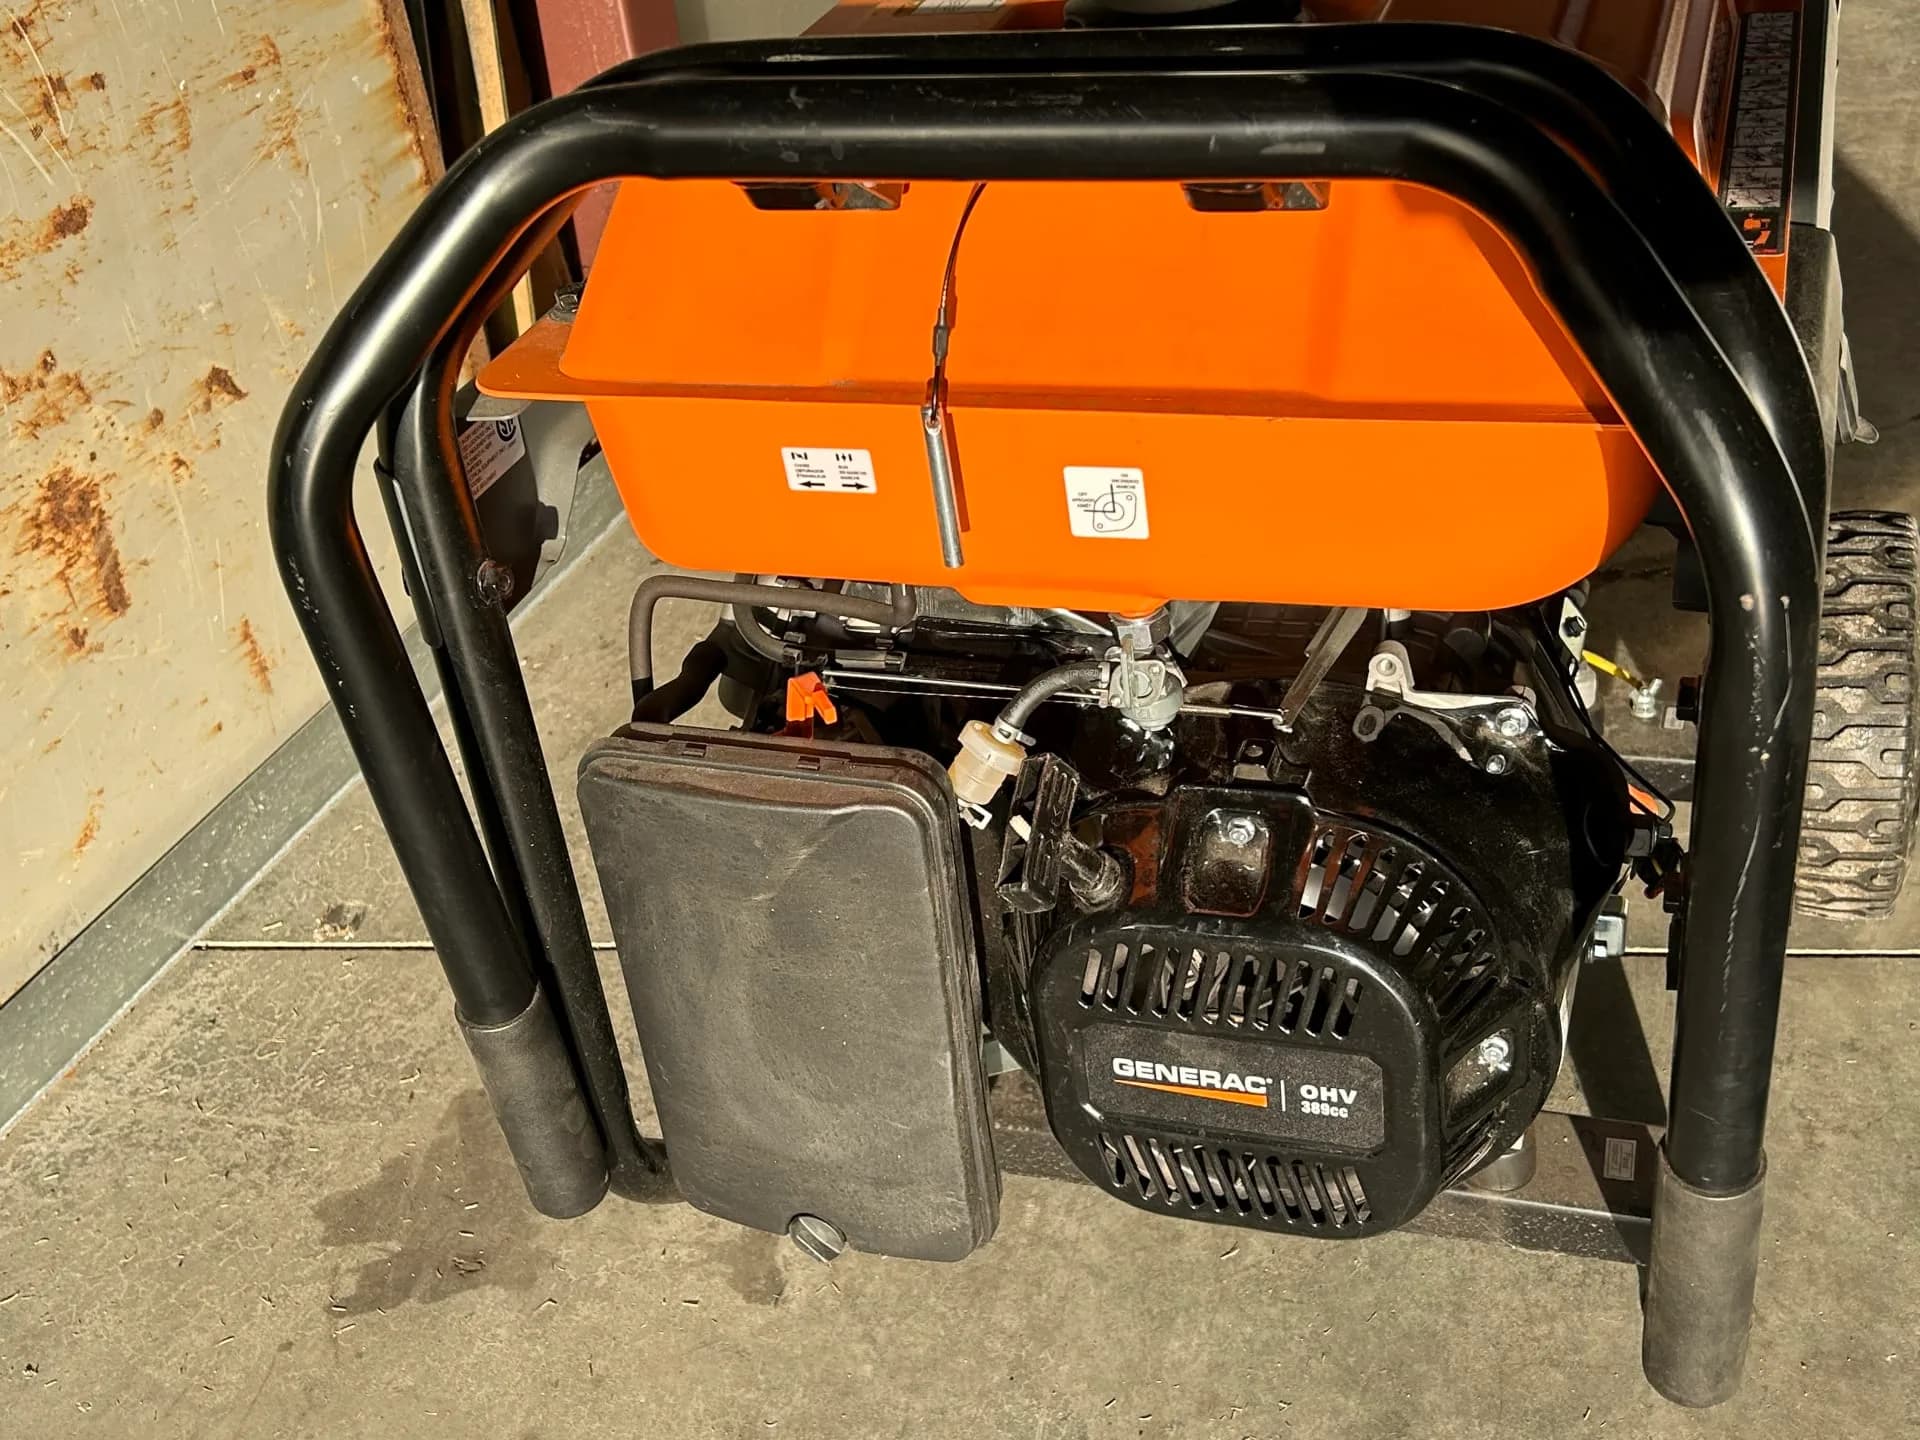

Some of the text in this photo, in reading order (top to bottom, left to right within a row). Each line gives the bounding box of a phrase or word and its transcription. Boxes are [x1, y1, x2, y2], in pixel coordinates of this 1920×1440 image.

[1112, 1057, 1267, 1094] GENERAC
[1299, 1084, 1358, 1105] OHV
[1300, 1100, 1349, 1118] 389cc
